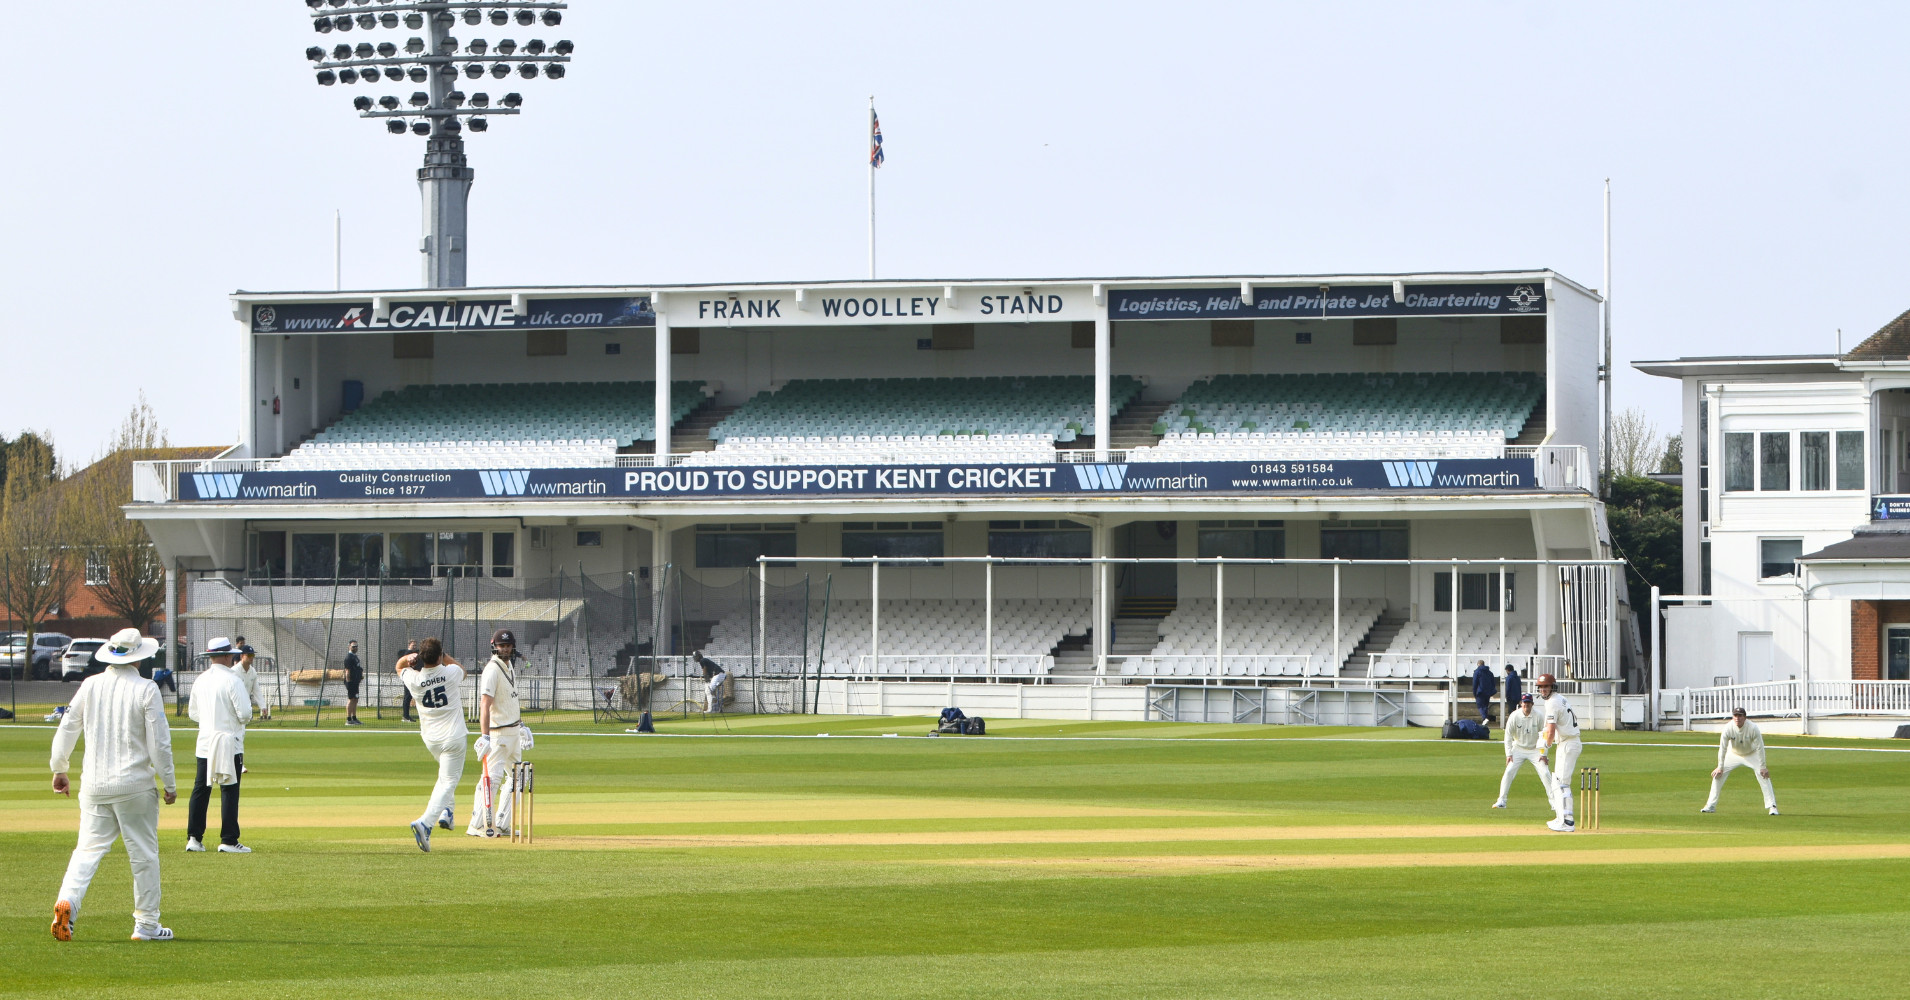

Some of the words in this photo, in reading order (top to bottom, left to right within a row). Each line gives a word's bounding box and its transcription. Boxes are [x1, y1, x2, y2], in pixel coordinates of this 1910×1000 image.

[699, 300, 781, 319] FRANK
[822, 298, 940, 318] WOOLLEY
[980, 295, 1063, 315] STAND
[1119, 297, 1201, 314] Logistics,
[1258, 295, 1293, 310] and
[1293, 293, 1356, 310] Private
[1359, 294, 1389, 309] Jet
[1404, 292, 1501, 310] Chartering
[1250, 464, 1287, 474] 01843
[1290, 463, 1334, 474] 591584
[339, 473, 378, 485] Quality
[381, 473, 451, 484] Construction
[624, 471, 709, 492] PROUD
[712, 470, 746, 491] TO
[752, 469, 869, 490] SUPPORT
[875, 468, 941, 489] KENT
[947, 467, 1056, 488] CRICKET
[1127, 473, 1208, 490] wwmartin
[1231, 477, 1354, 488] www.wwmartin.co.uk
[1437, 471, 1520, 487] wwmartin
[242, 482, 317, 498] wwmartin
[364, 485, 395, 496] Since
[399, 485, 426, 496] 1877
[529, 479, 607, 496] wwmartin
[421, 676, 446, 688] COHEN
[422, 686, 448, 708] 45
